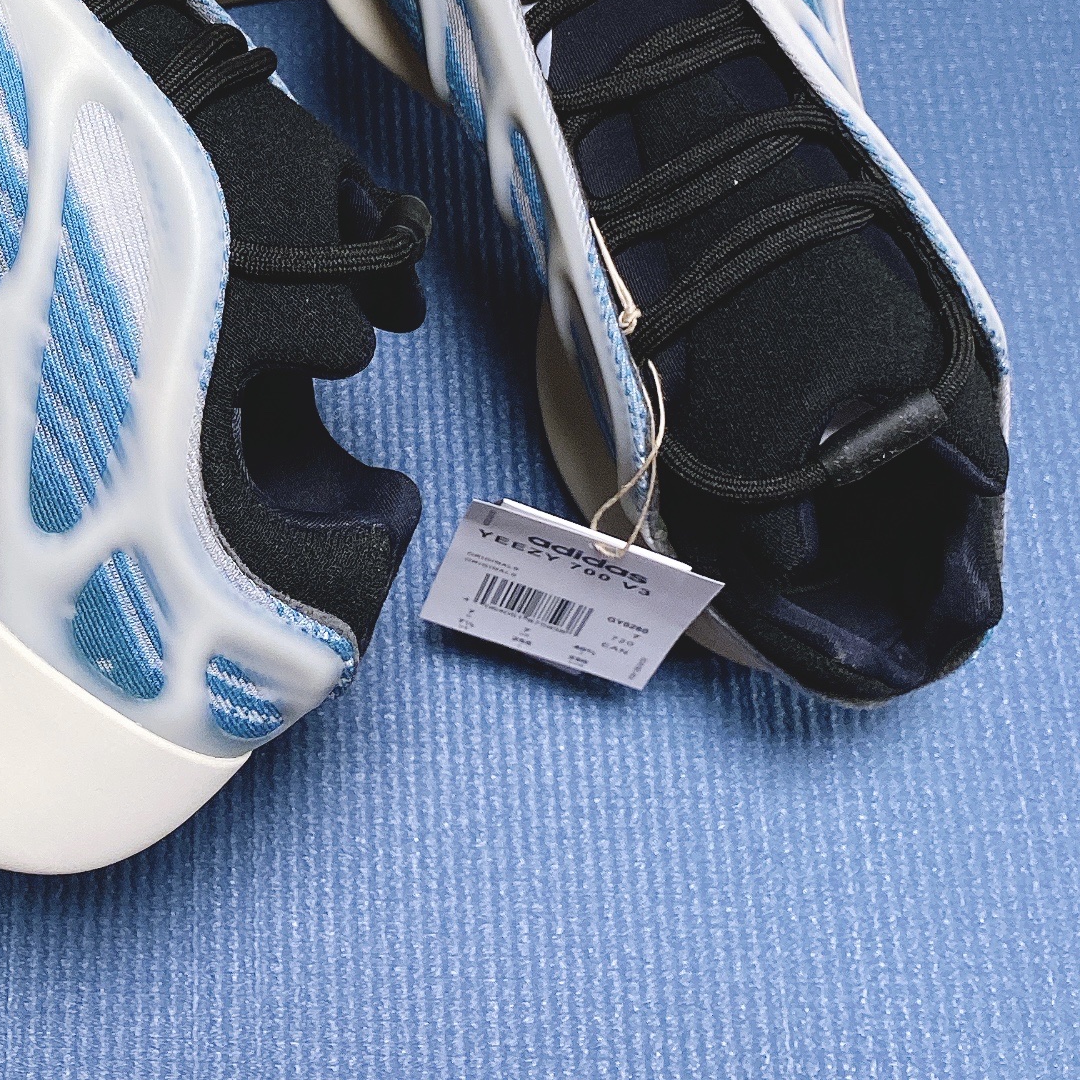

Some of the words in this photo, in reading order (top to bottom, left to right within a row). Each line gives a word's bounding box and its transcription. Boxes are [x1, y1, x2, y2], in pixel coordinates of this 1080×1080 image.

[478, 527, 561, 562] YEEZY
[570, 561, 612, 582] 700
[622, 580, 651, 597] V3
[528, 536, 648, 585] adidas
